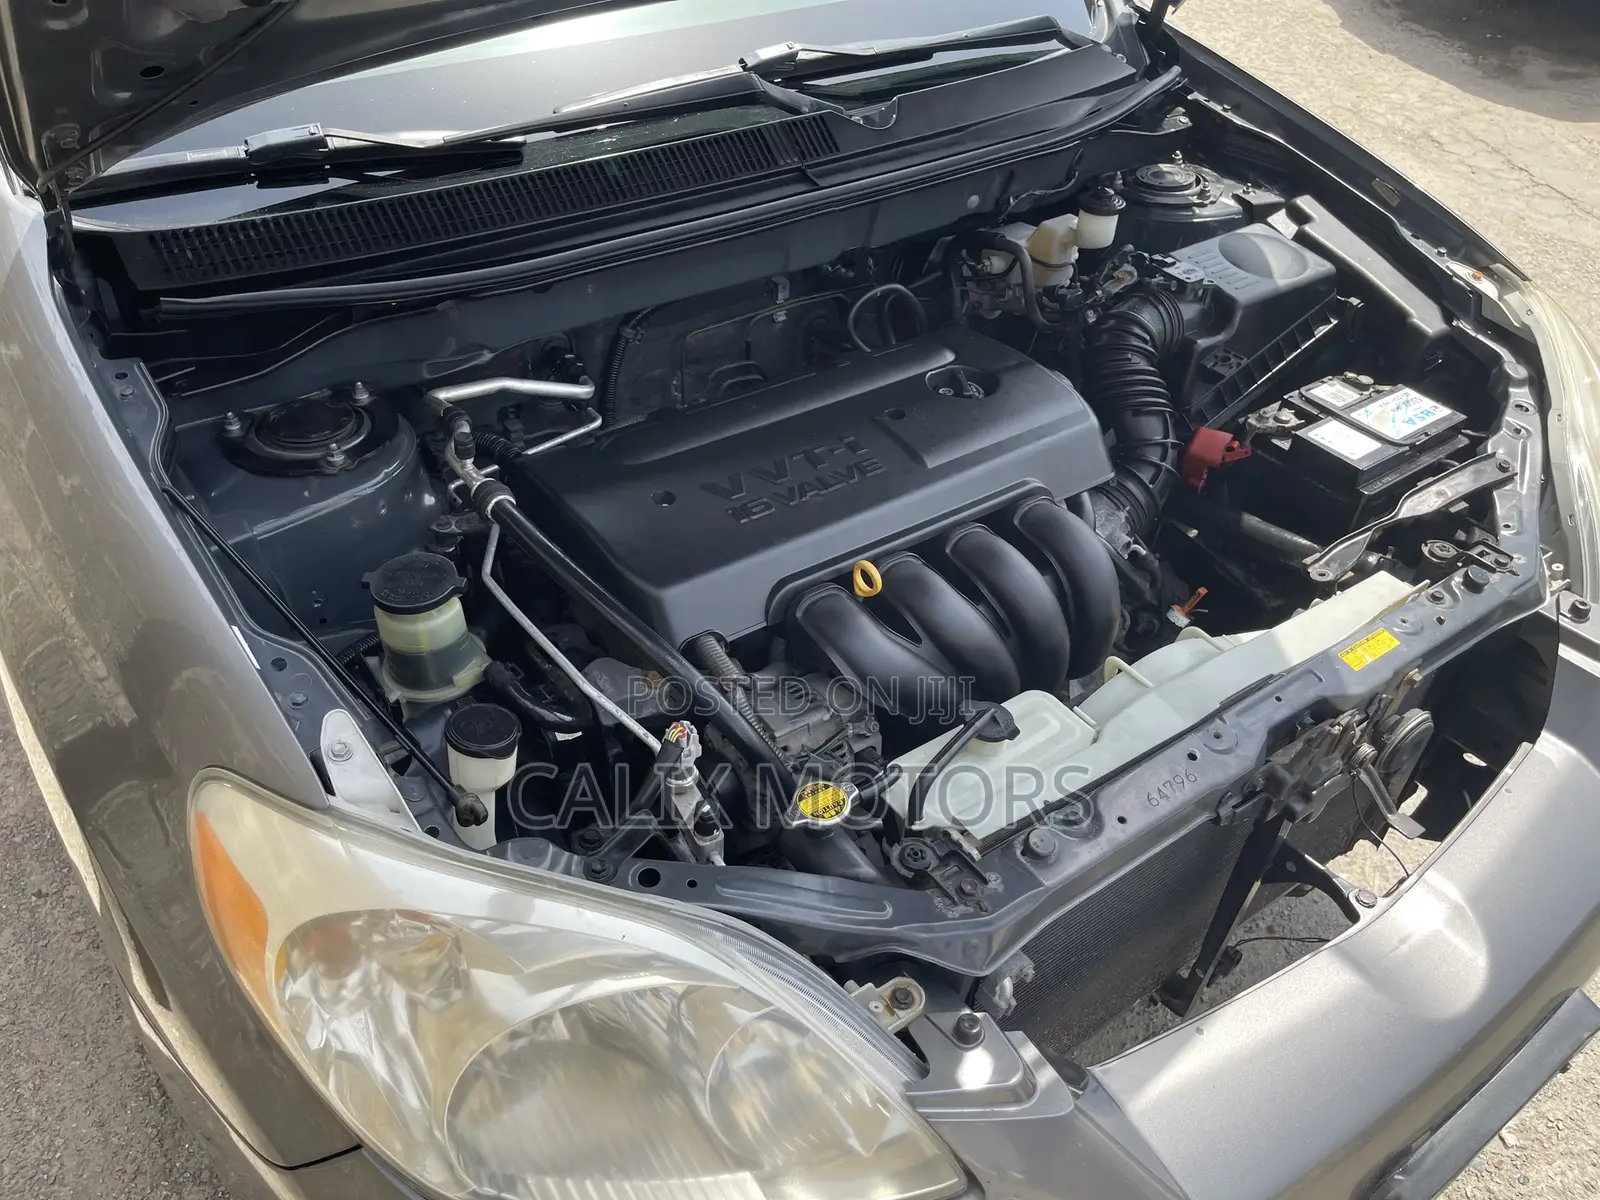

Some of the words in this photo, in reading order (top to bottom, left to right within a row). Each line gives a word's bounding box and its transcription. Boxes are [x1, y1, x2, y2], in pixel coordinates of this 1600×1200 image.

[726, 498, 776, 523] 16
[770, 458, 887, 505] VALVE
[1146, 769, 1198, 807] 64796
[813, 800, 844, 816] CAUTION
